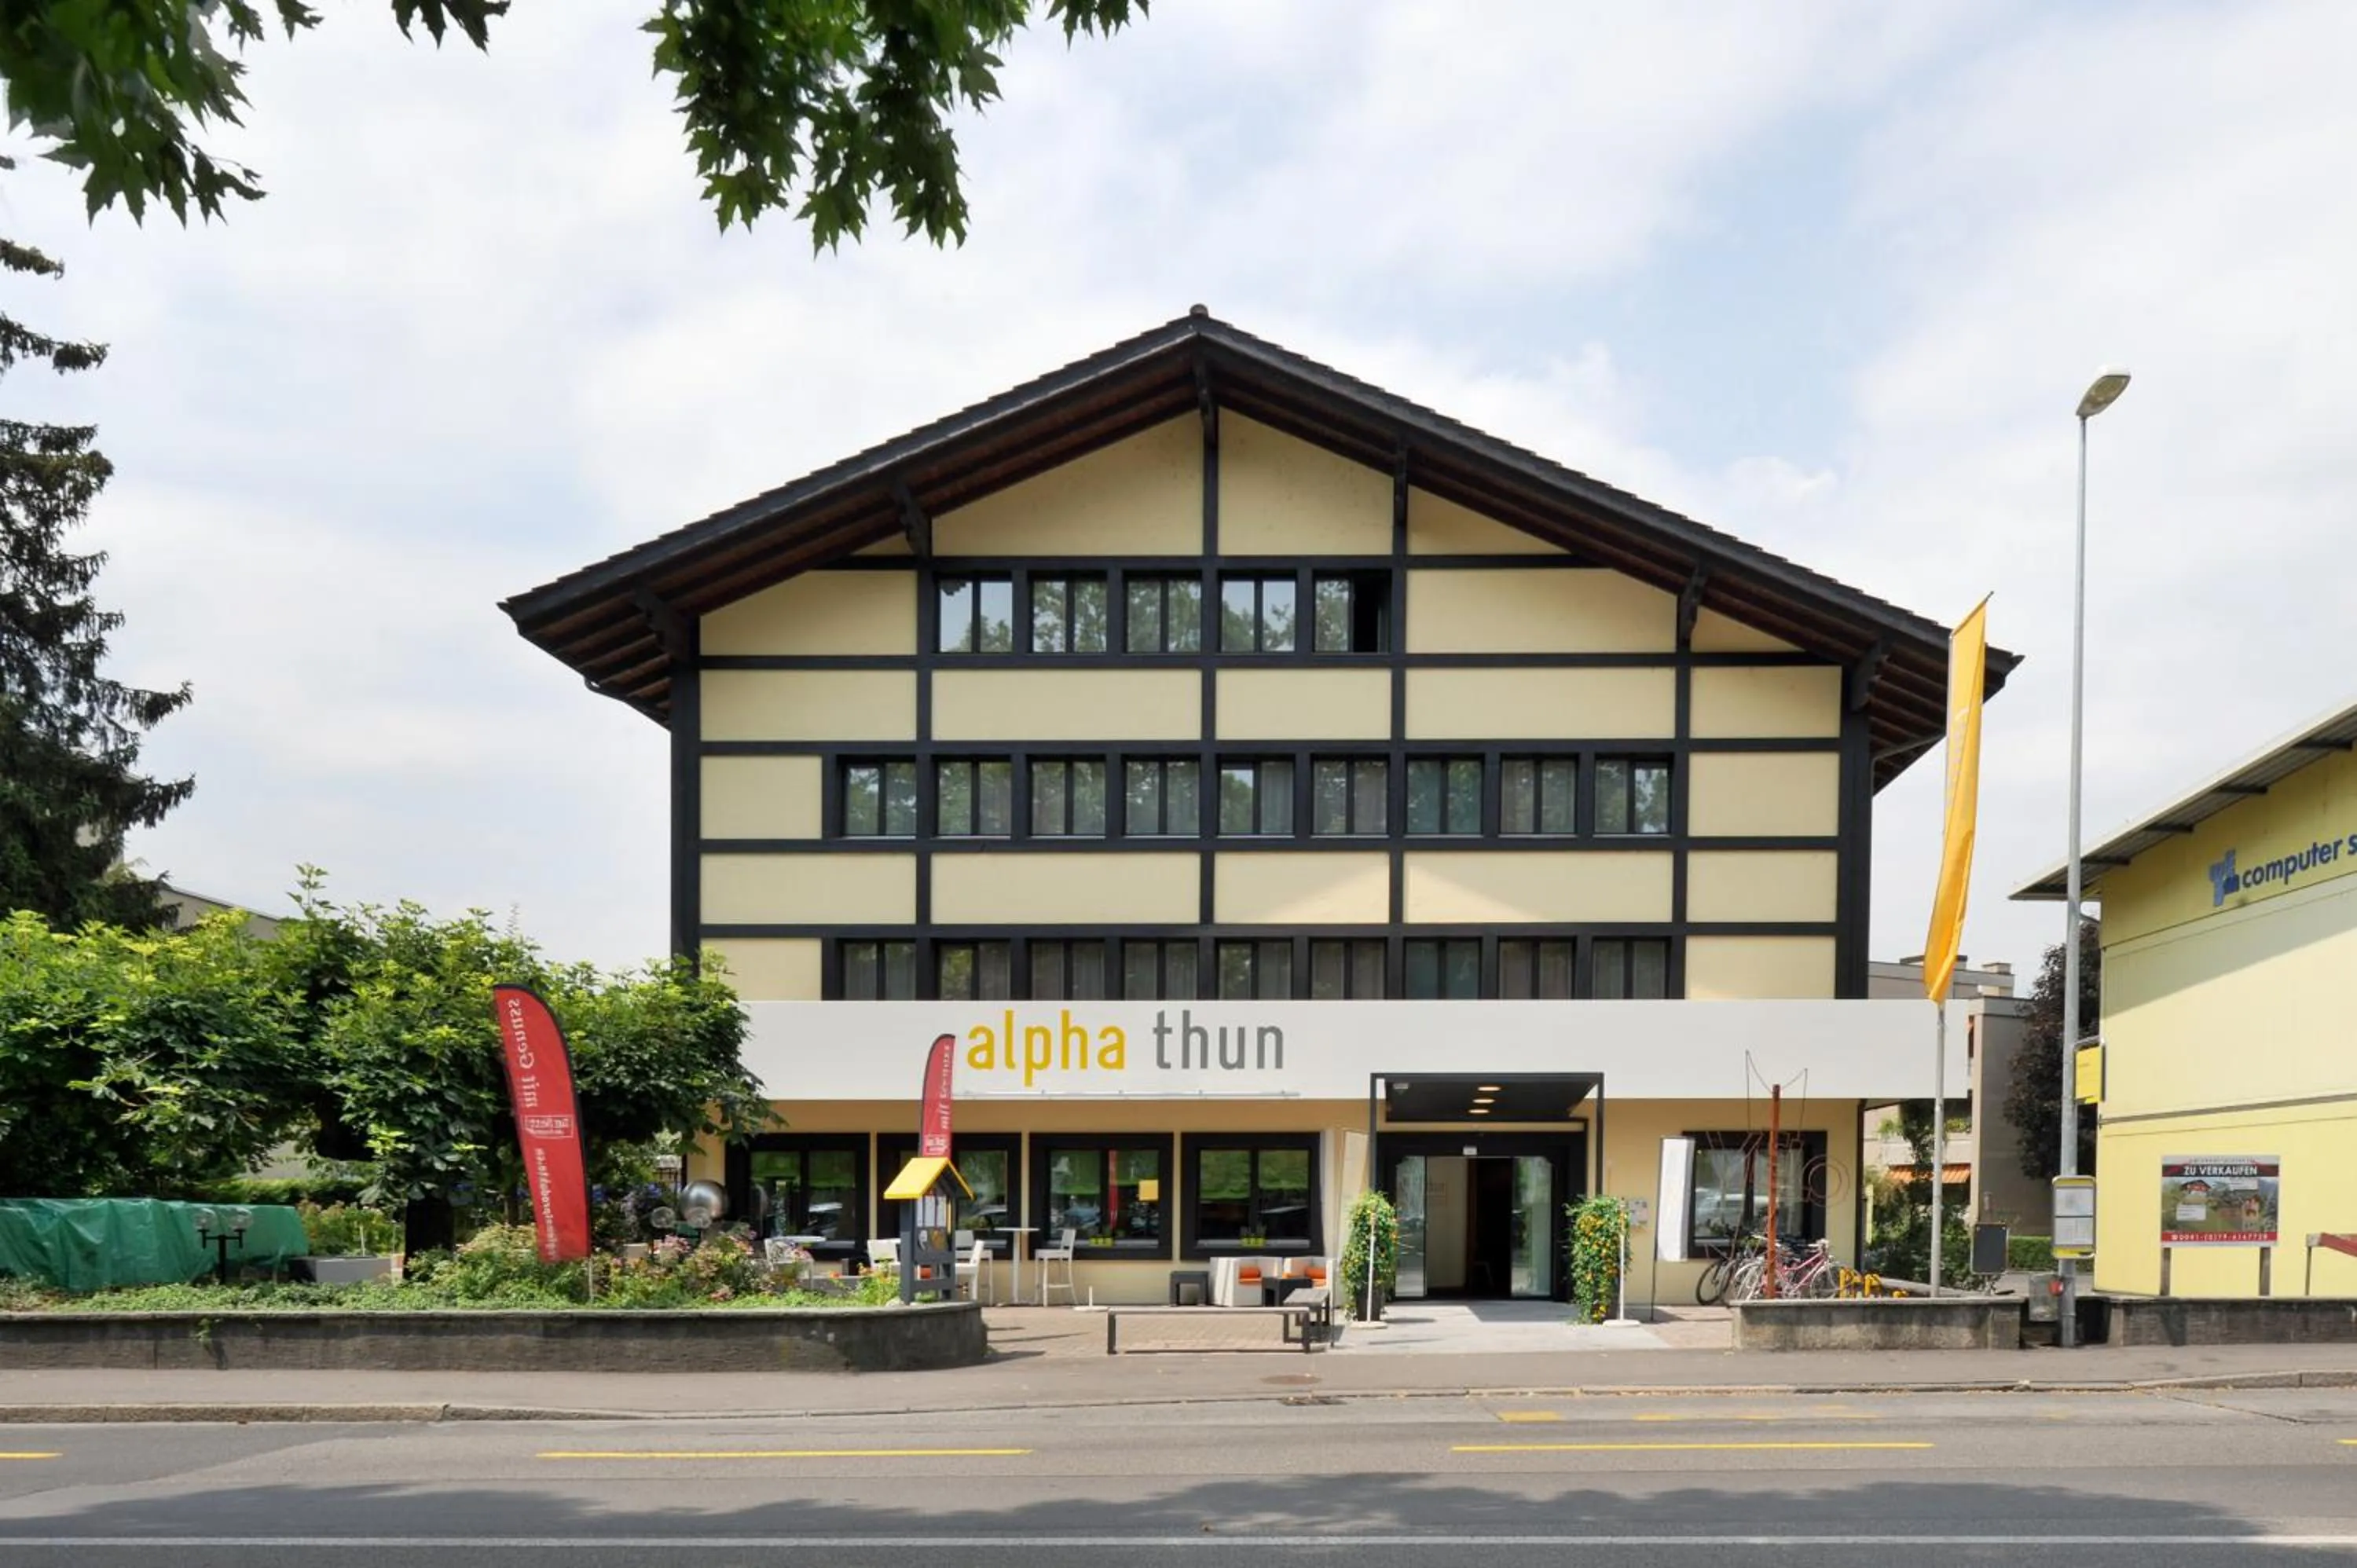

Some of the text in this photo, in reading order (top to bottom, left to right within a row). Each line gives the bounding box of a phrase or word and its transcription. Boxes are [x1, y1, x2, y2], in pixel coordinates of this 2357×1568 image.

[2242, 839, 2343, 888] computer
[967, 1009, 1283, 1086] alpha thun
[2183, 1165, 2257, 1175] ZU VERKAUFEN
